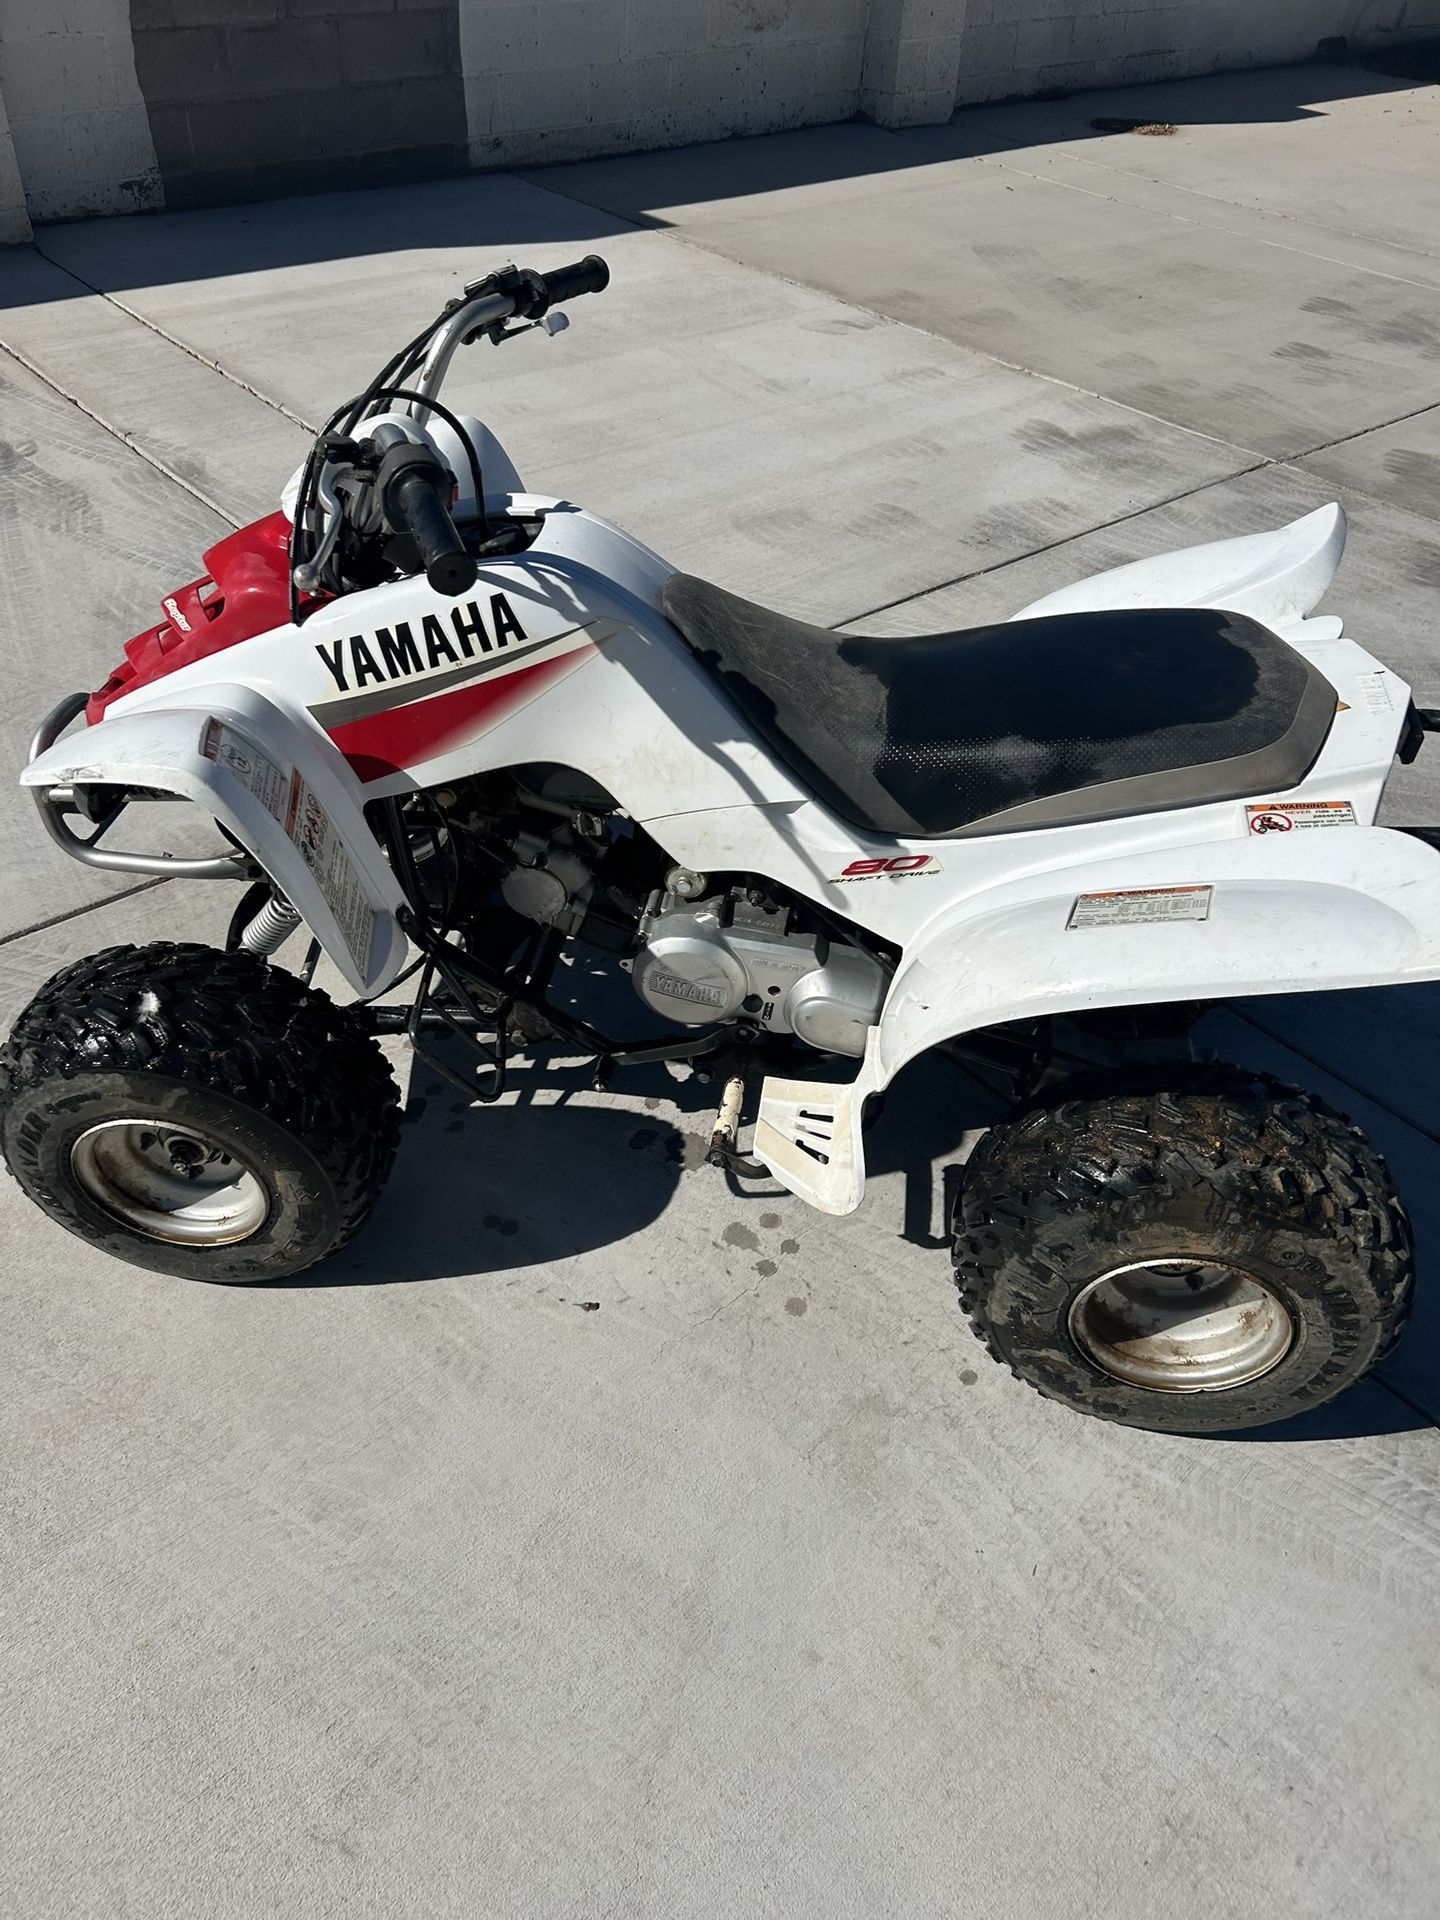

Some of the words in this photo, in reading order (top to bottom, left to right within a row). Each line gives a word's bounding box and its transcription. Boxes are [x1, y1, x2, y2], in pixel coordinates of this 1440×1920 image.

[164, 598, 192, 631] Raptor
[315, 592, 528, 692] YAMAHA
[1279, 802, 1328, 810] WARNING
[828, 875, 888, 885] SHAFT
[889, 869, 942, 879] DRIVE
[841, 855, 930, 876] 80
[656, 975, 720, 1005] YAMAHA
